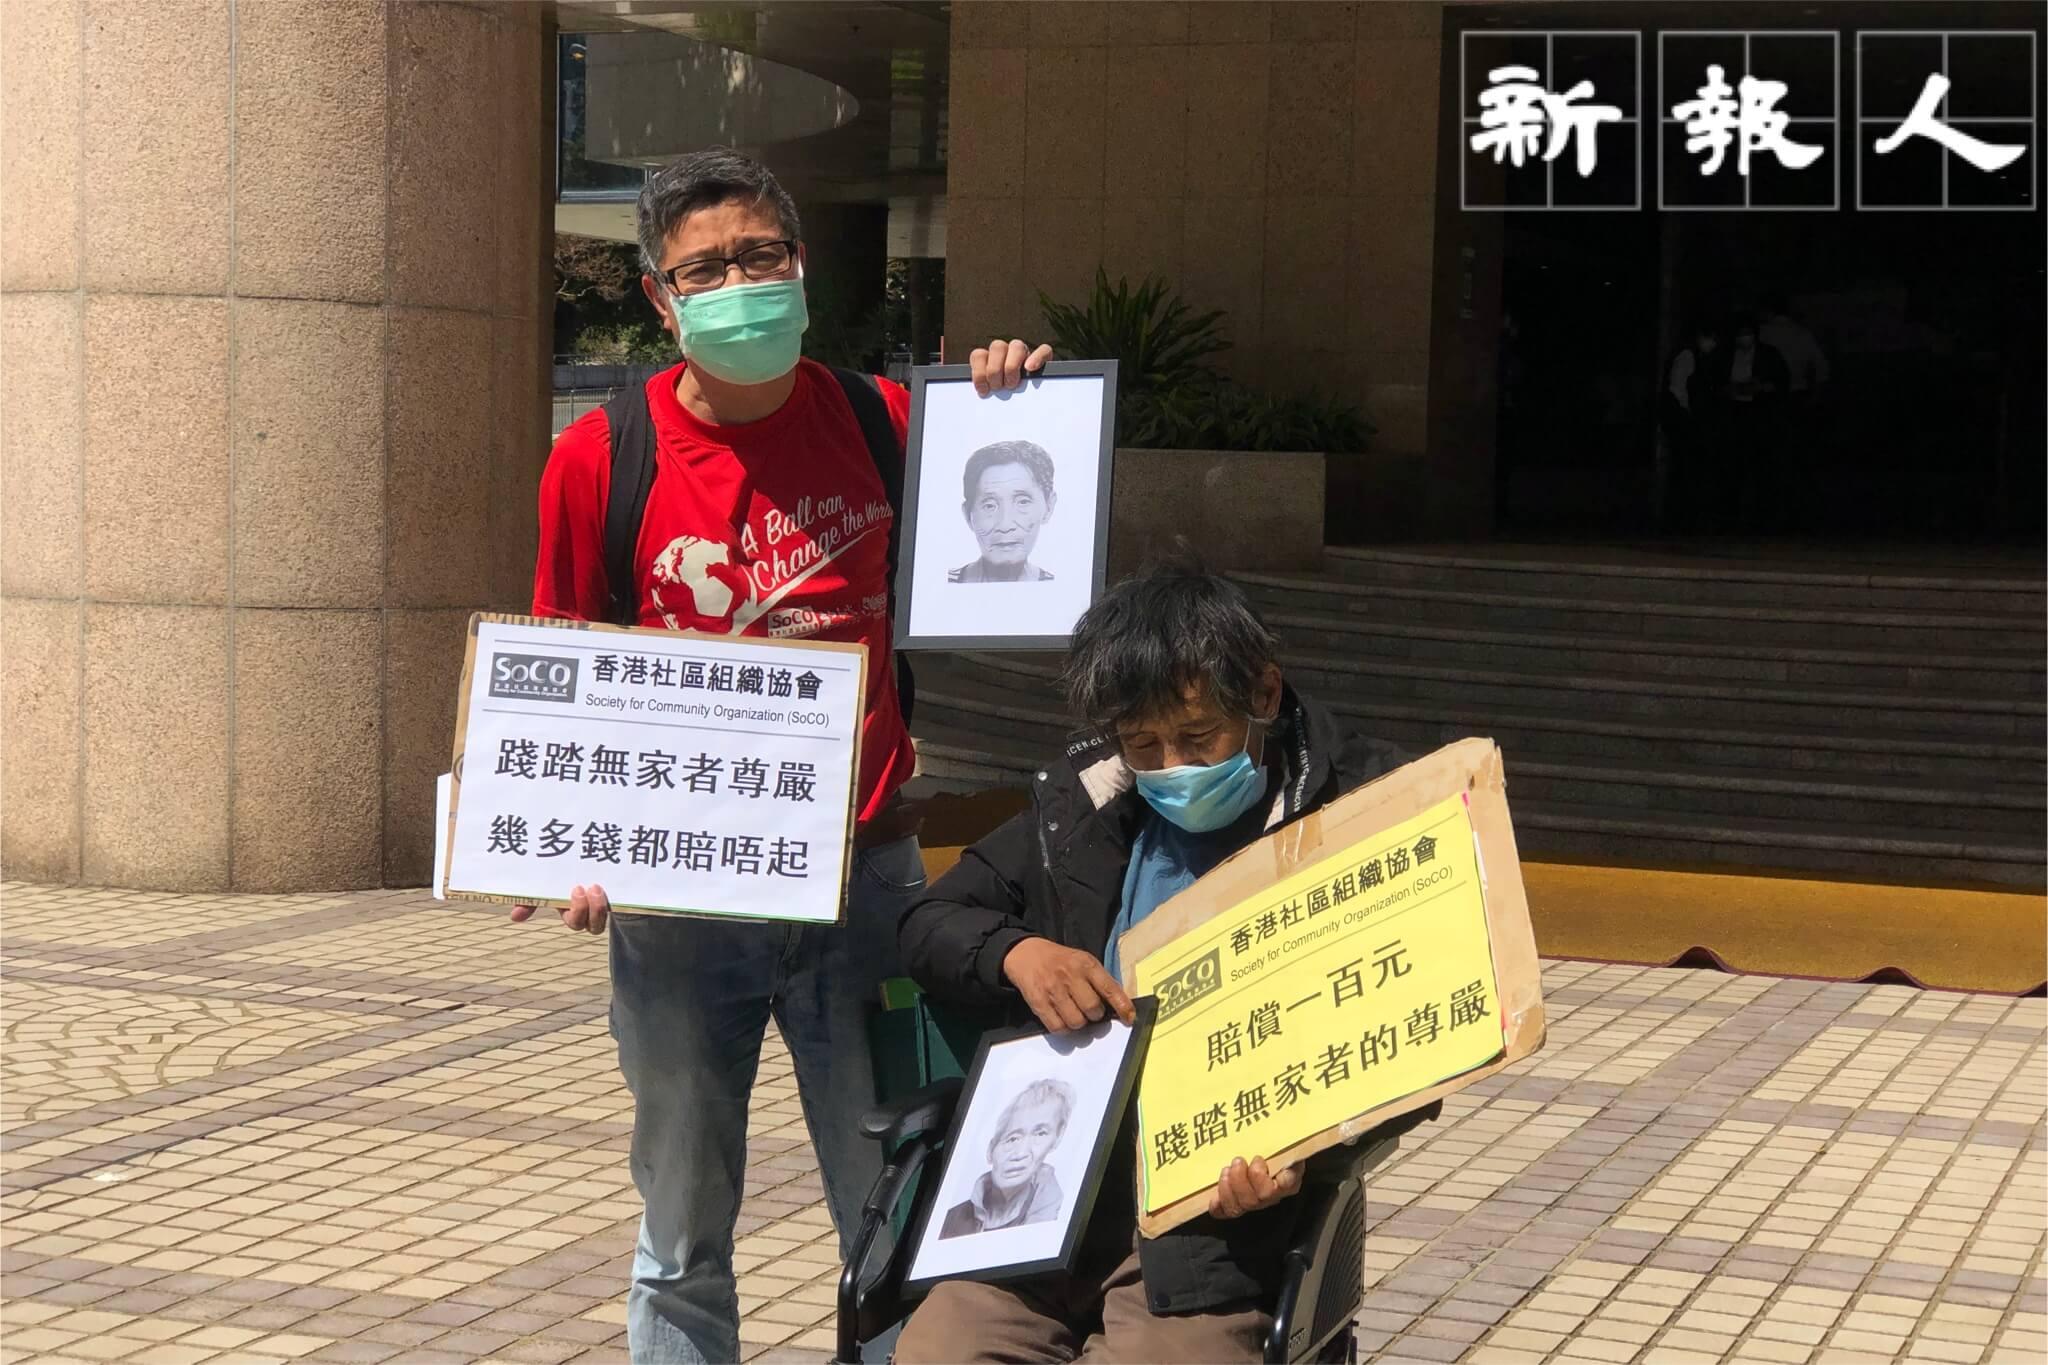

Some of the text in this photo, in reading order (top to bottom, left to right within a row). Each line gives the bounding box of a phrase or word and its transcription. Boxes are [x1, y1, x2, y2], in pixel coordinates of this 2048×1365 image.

[740, 494, 846, 560] A Ball can
[753, 525, 841, 592] Change
[841, 507, 866, 537] the
[771, 610, 813, 629] SoCO
[495, 656, 572, 687] SoCO
[592, 654, 824, 701] 香港社區組織協會
[585, 693, 830, 729] Society for Community Organization (SoCO)
[494, 737, 818, 803] 踐踏無家者尊嚴
[486, 814, 810, 879] 幾多錢都賠唔起
[1229, 835, 1438, 957] 香港社區組織協會
[1230, 864, 1454, 982] Society for Community Organization (SoCO)
[1156, 957, 1215, 1007] SoCO
[1206, 938, 1414, 1072] 賠償一百元
[1154, 978, 1493, 1172] 踐踏無家者的尊嚴
